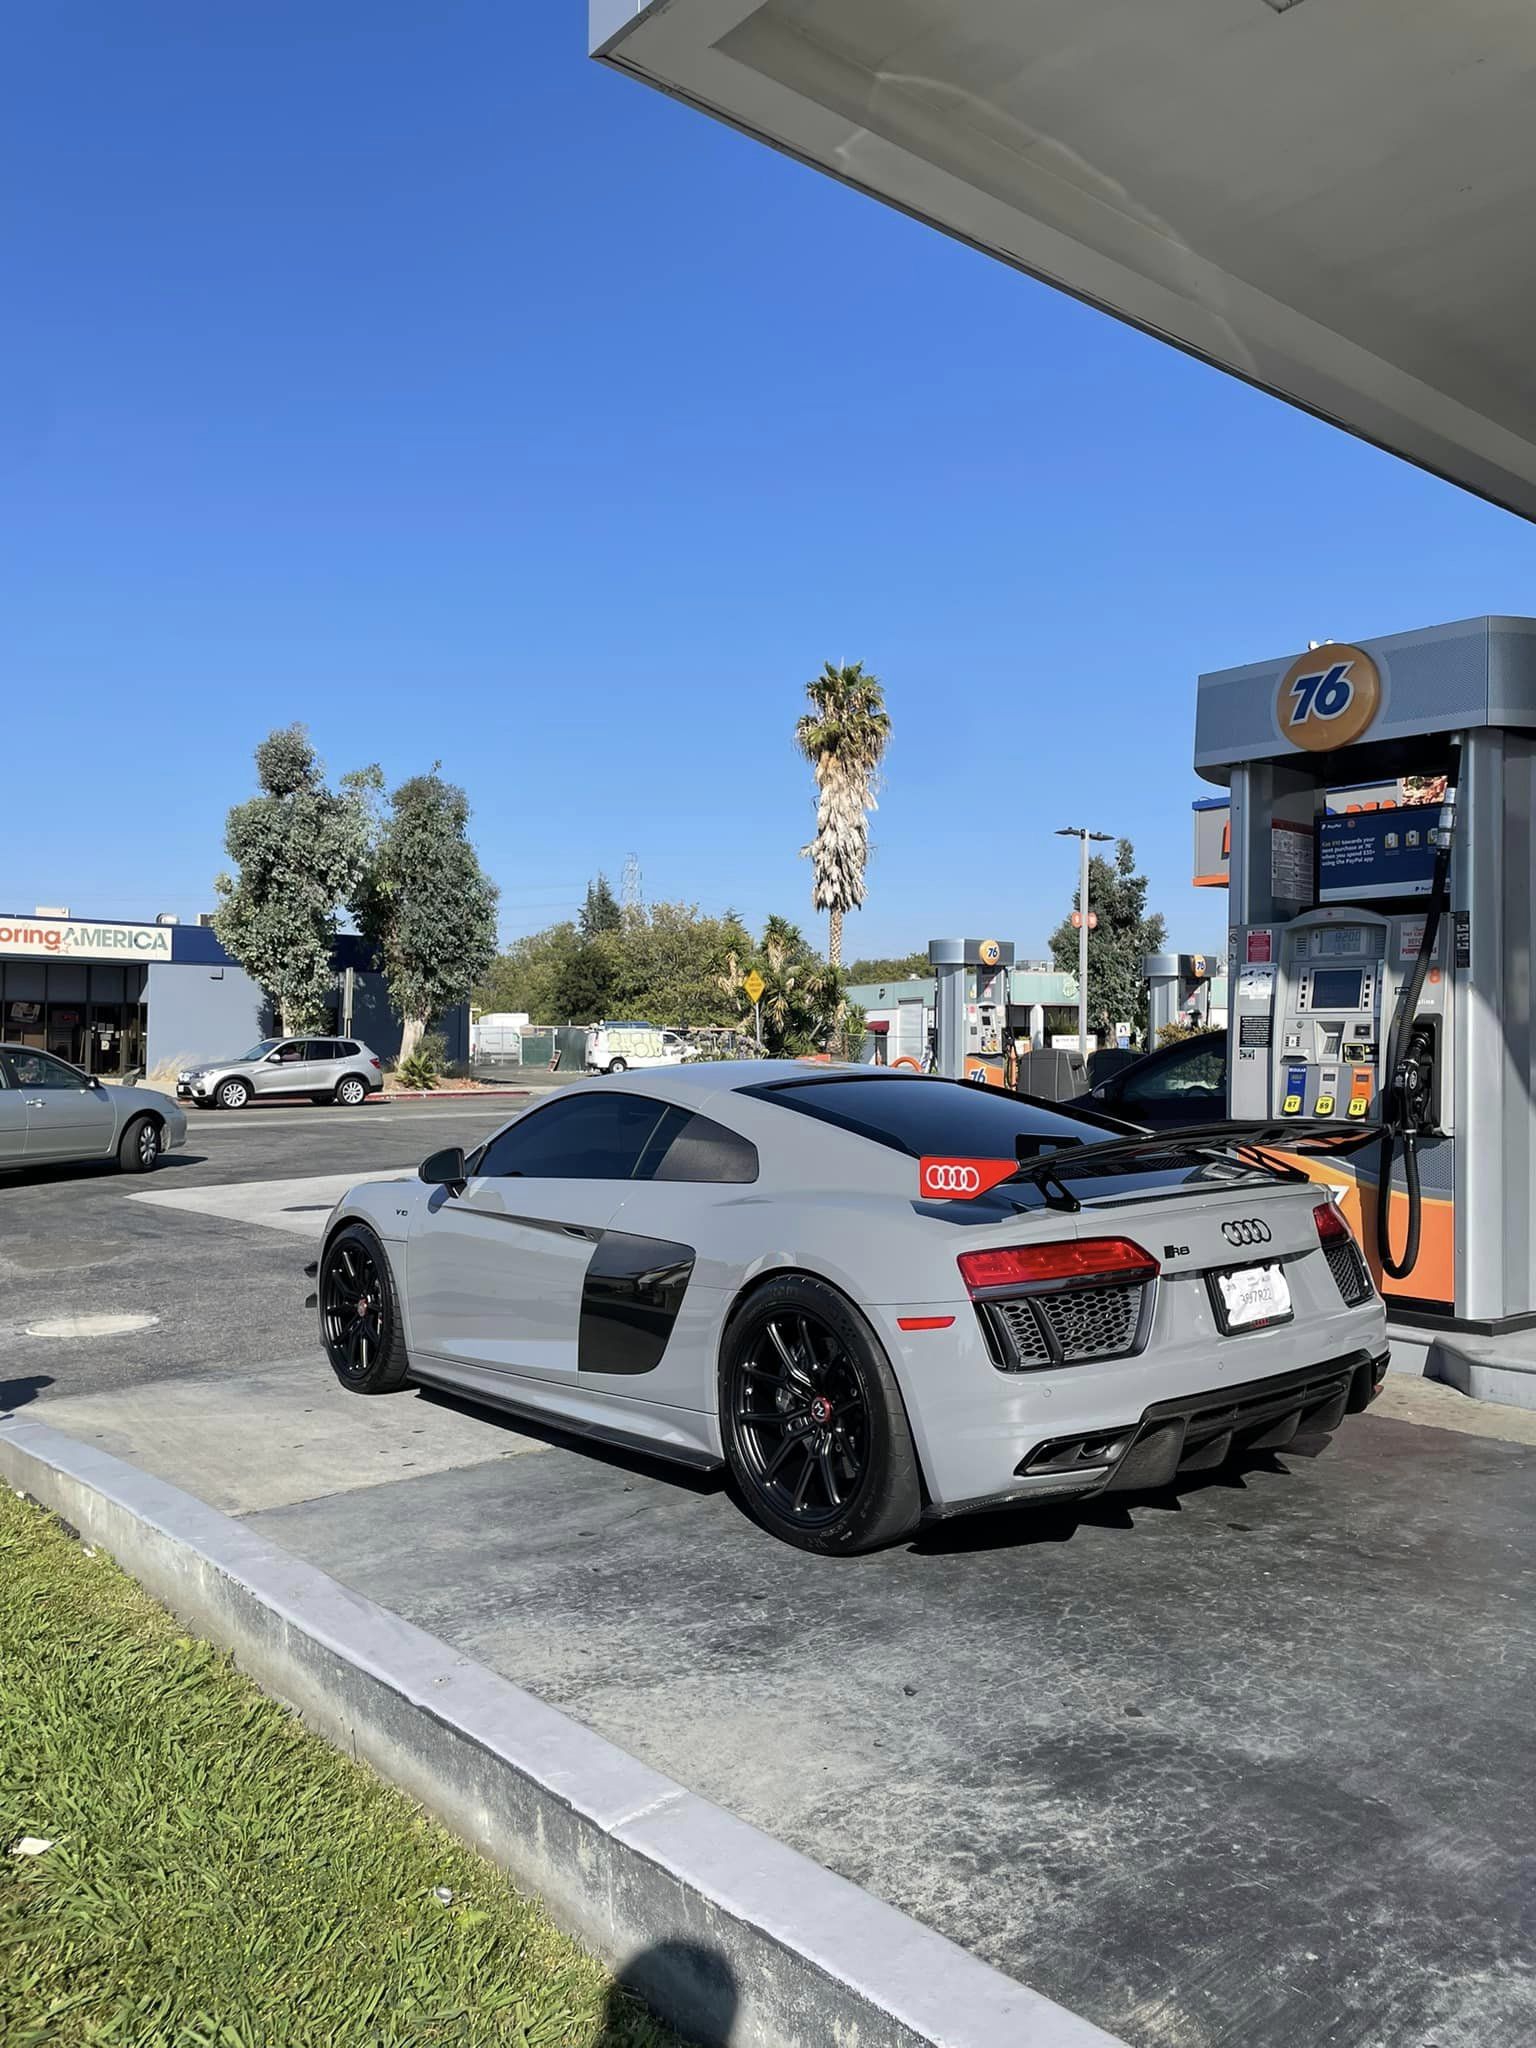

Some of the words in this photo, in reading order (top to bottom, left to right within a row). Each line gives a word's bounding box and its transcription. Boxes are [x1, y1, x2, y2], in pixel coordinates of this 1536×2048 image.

[1289, 661, 1354, 726] 76
[1334, 845, 1357, 854] purchase
[1346, 851, 1362, 859] spend
[0, 926, 61, 951] oring
[62, 927, 168, 950] AMERICA
[987, 947, 998, 958] 76
[1196, 961, 1206, 970] 76
[1319, 1102, 1330, 1110] 89
[1352, 1104, 1363, 1112] 91
[1167, 1246, 1190, 1257] R8
